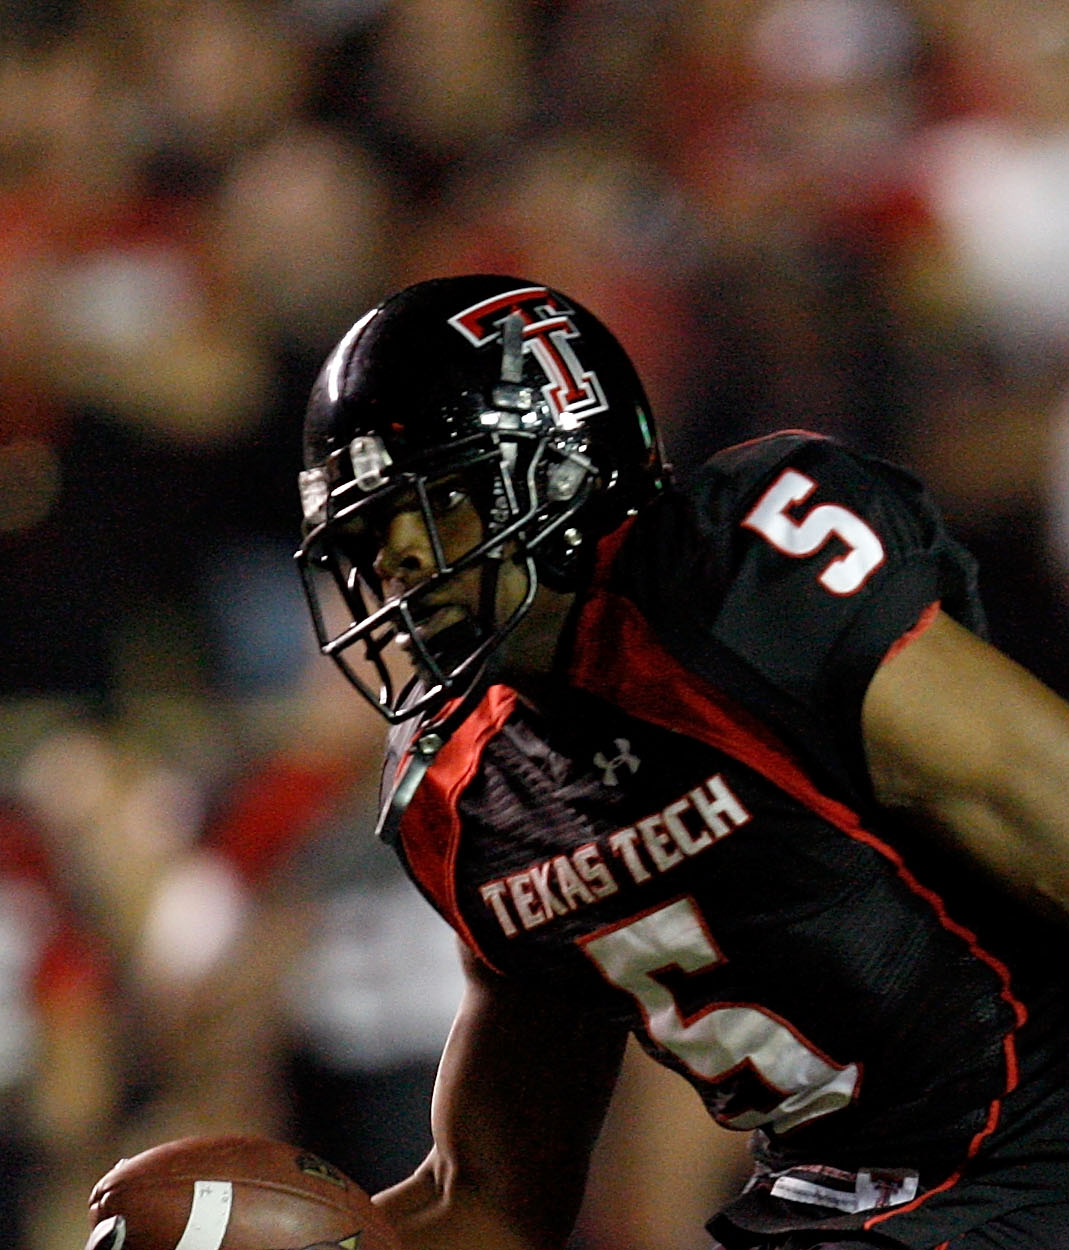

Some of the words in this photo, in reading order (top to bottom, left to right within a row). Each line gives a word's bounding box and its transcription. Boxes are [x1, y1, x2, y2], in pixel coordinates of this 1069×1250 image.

[740, 466, 886, 596] 5
[478, 842, 620, 938] TEXAS
[607, 772, 754, 886] TECH
[574, 893, 864, 1135] 5
